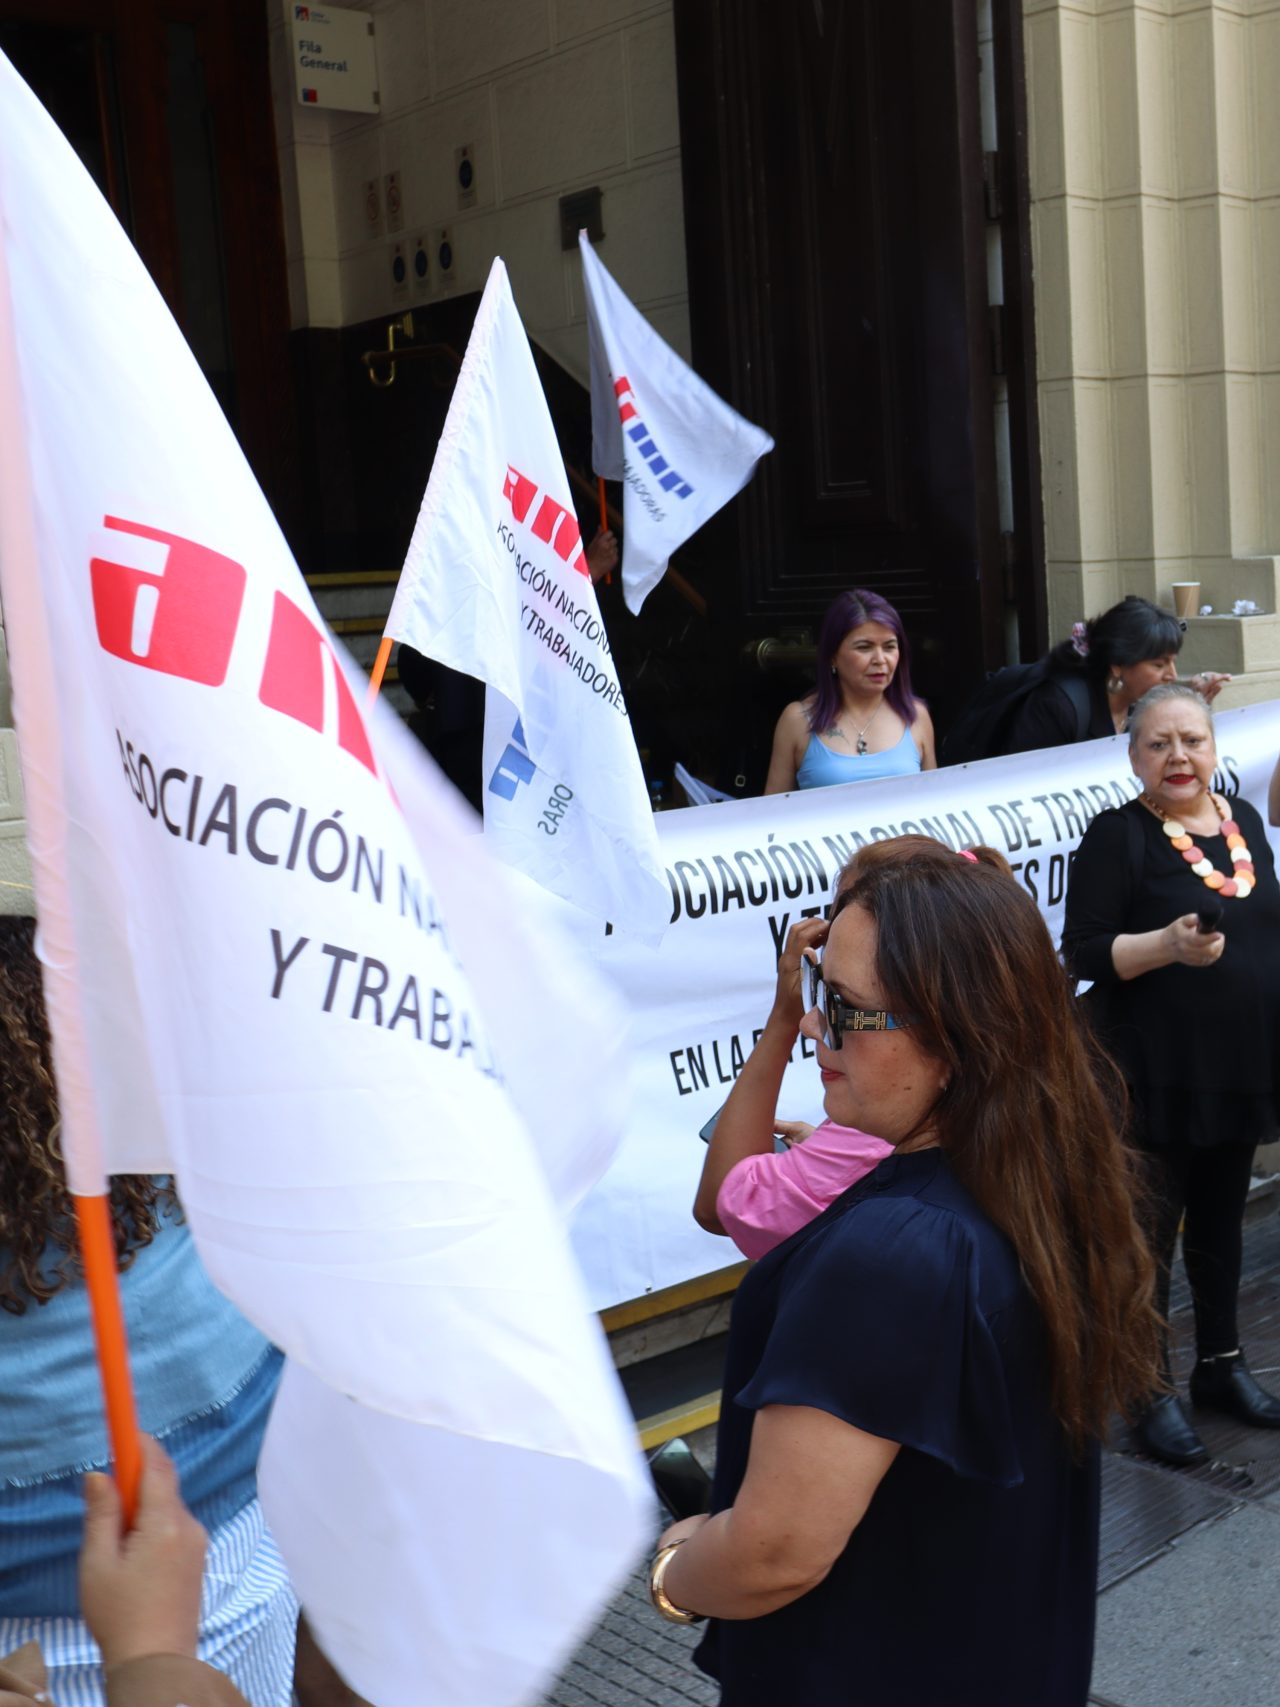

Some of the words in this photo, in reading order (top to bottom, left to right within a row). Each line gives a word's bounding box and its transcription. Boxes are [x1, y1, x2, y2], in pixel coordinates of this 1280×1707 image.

[299, 40, 321, 54] Fila
[300, 55, 347, 72] General
[988, 799, 1043, 853] DE
[268, 928, 310, 1001] Y
[768, 911, 790, 974] Y
[670, 1044, 710, 1096] EN
[712, 1034, 746, 1084] LA
